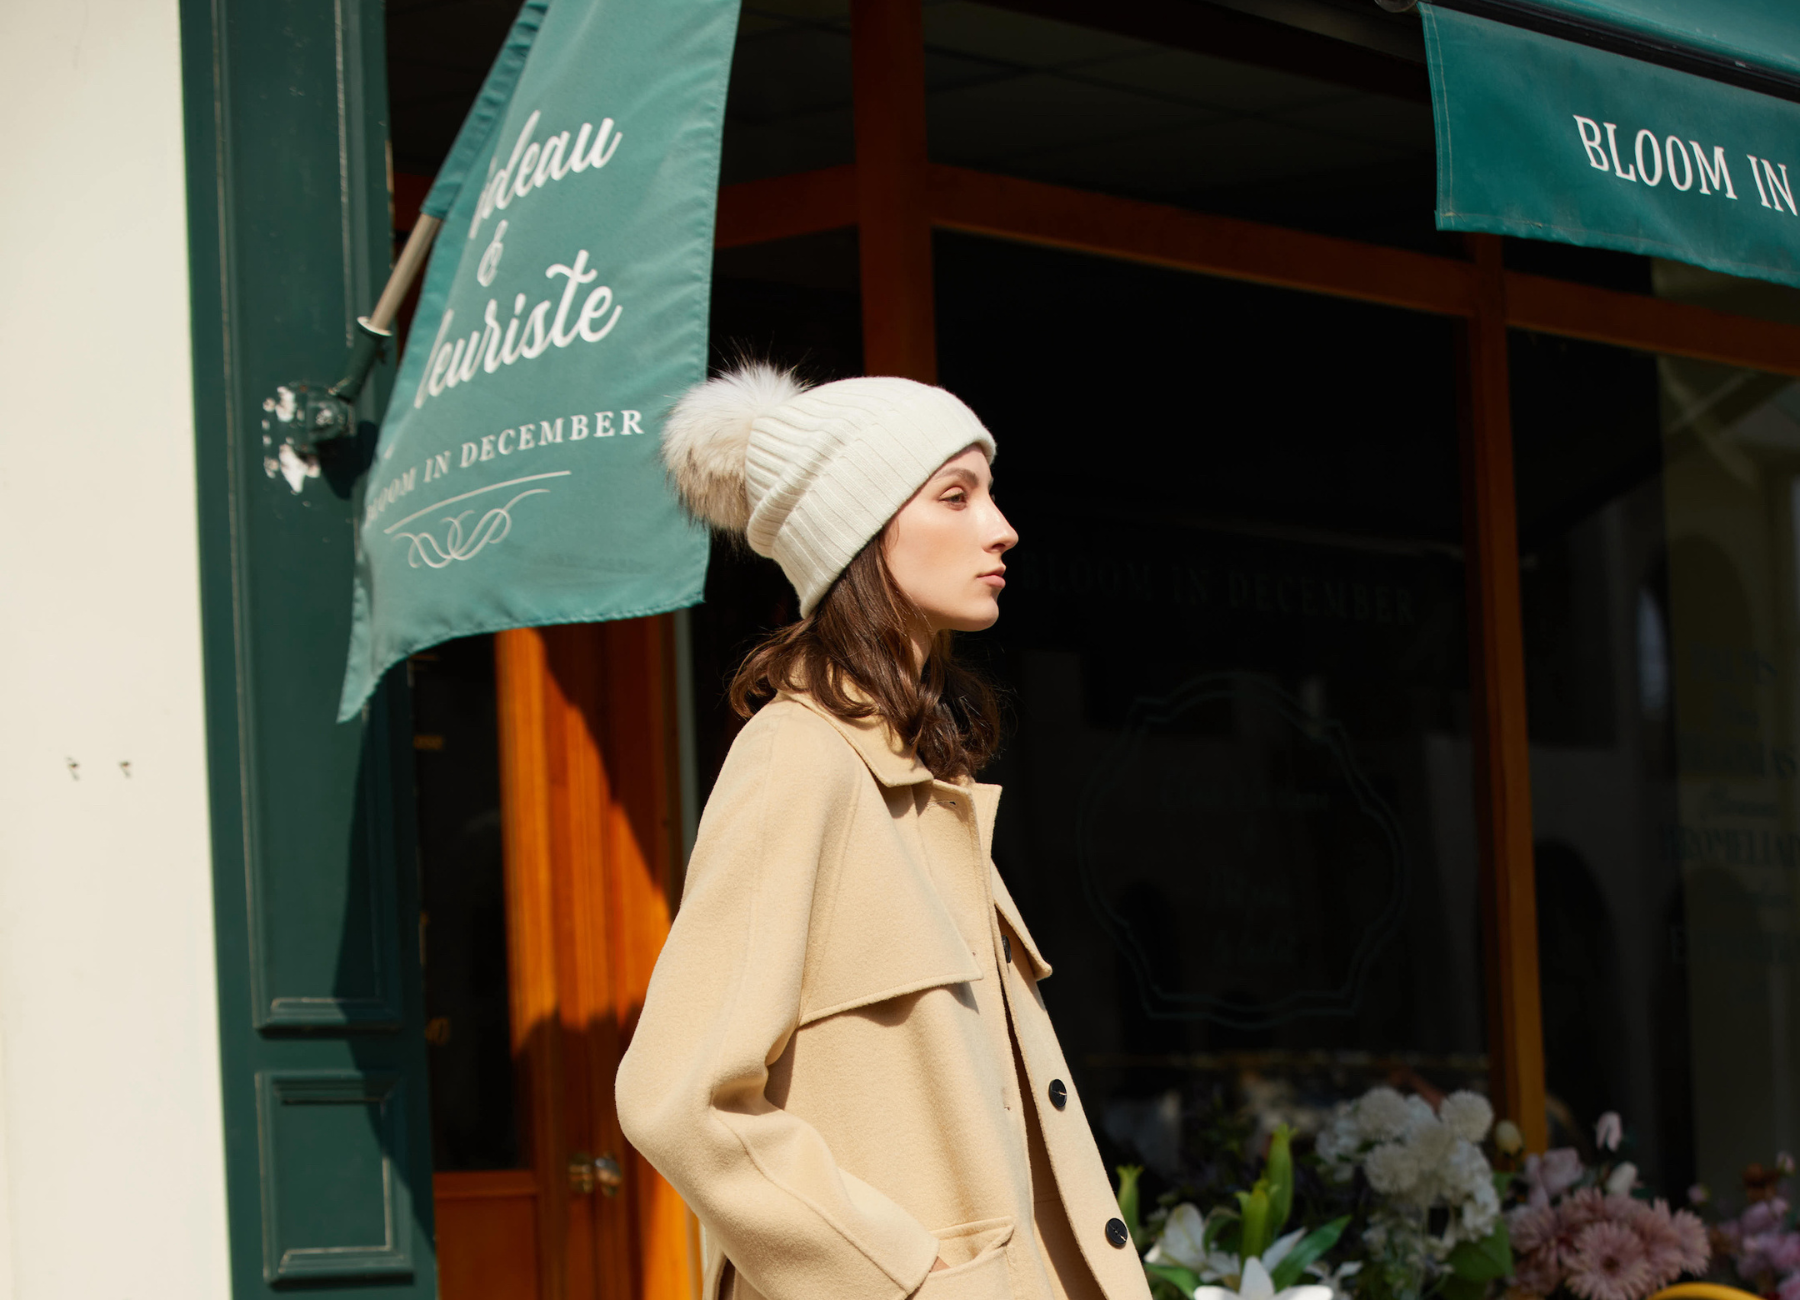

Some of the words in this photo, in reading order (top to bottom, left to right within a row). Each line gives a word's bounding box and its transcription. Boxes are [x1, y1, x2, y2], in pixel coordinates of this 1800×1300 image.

[1572, 114, 1738, 200] BLOOM
[1746, 153, 1798, 217] IN
[412, 249, 623, 409] leuriste
[423, 450, 451, 483] IN
[459, 409, 645, 469] DECEMBER
[1022, 551, 1152, 602] BLOOM
[1171, 562, 1209, 607] IN
[1228, 568, 1416, 625] DECEMBER
